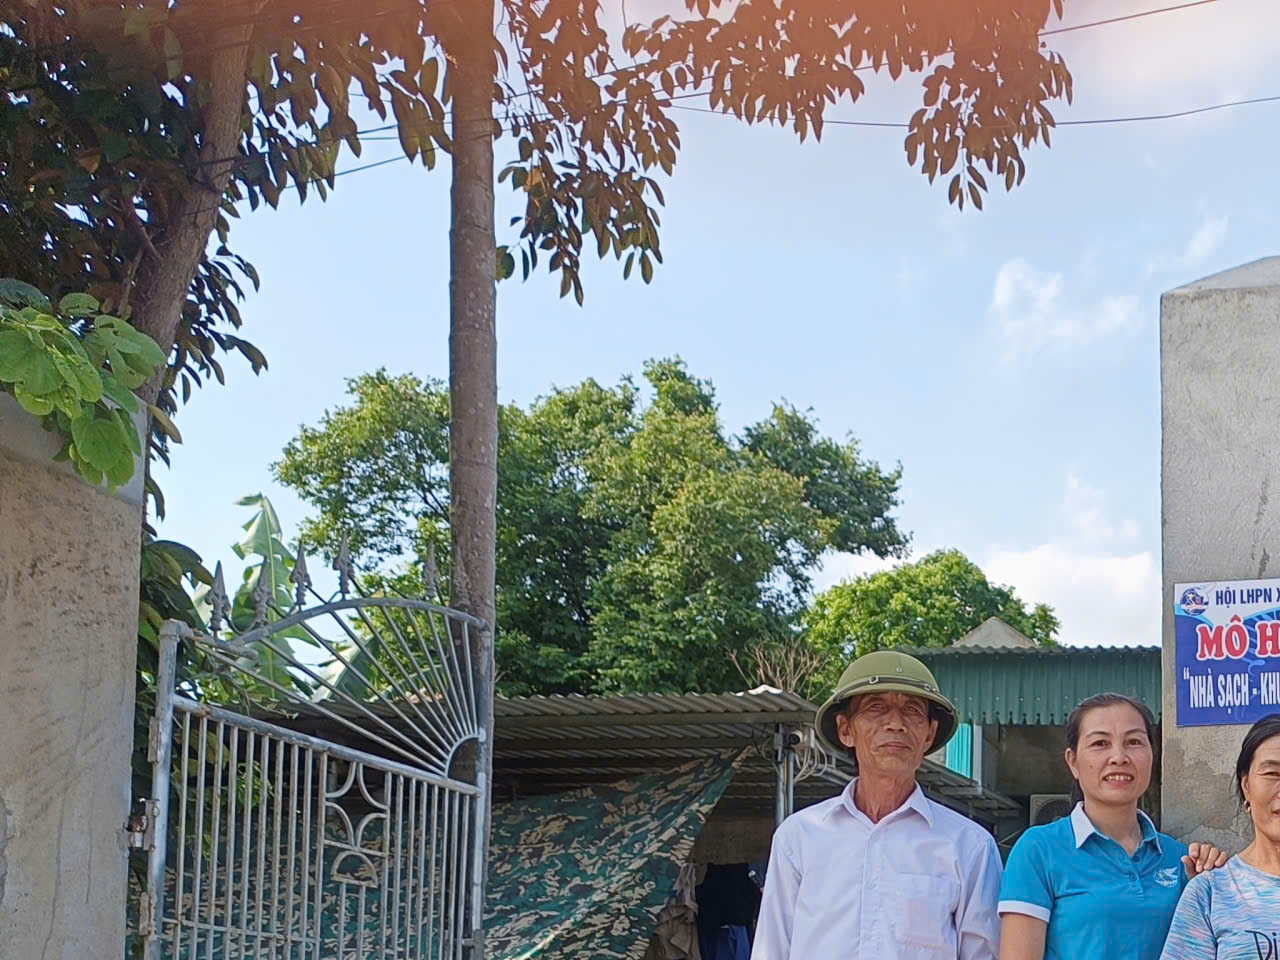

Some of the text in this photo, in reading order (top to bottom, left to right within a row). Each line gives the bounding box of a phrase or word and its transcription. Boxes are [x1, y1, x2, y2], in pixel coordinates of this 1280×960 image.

[1215, 586, 1236, 608] HỘI
[1240, 587, 1272, 604] LHPN
[1196, 614, 1249, 660] MÔ
[1217, 673, 1250, 714] SẠCH
